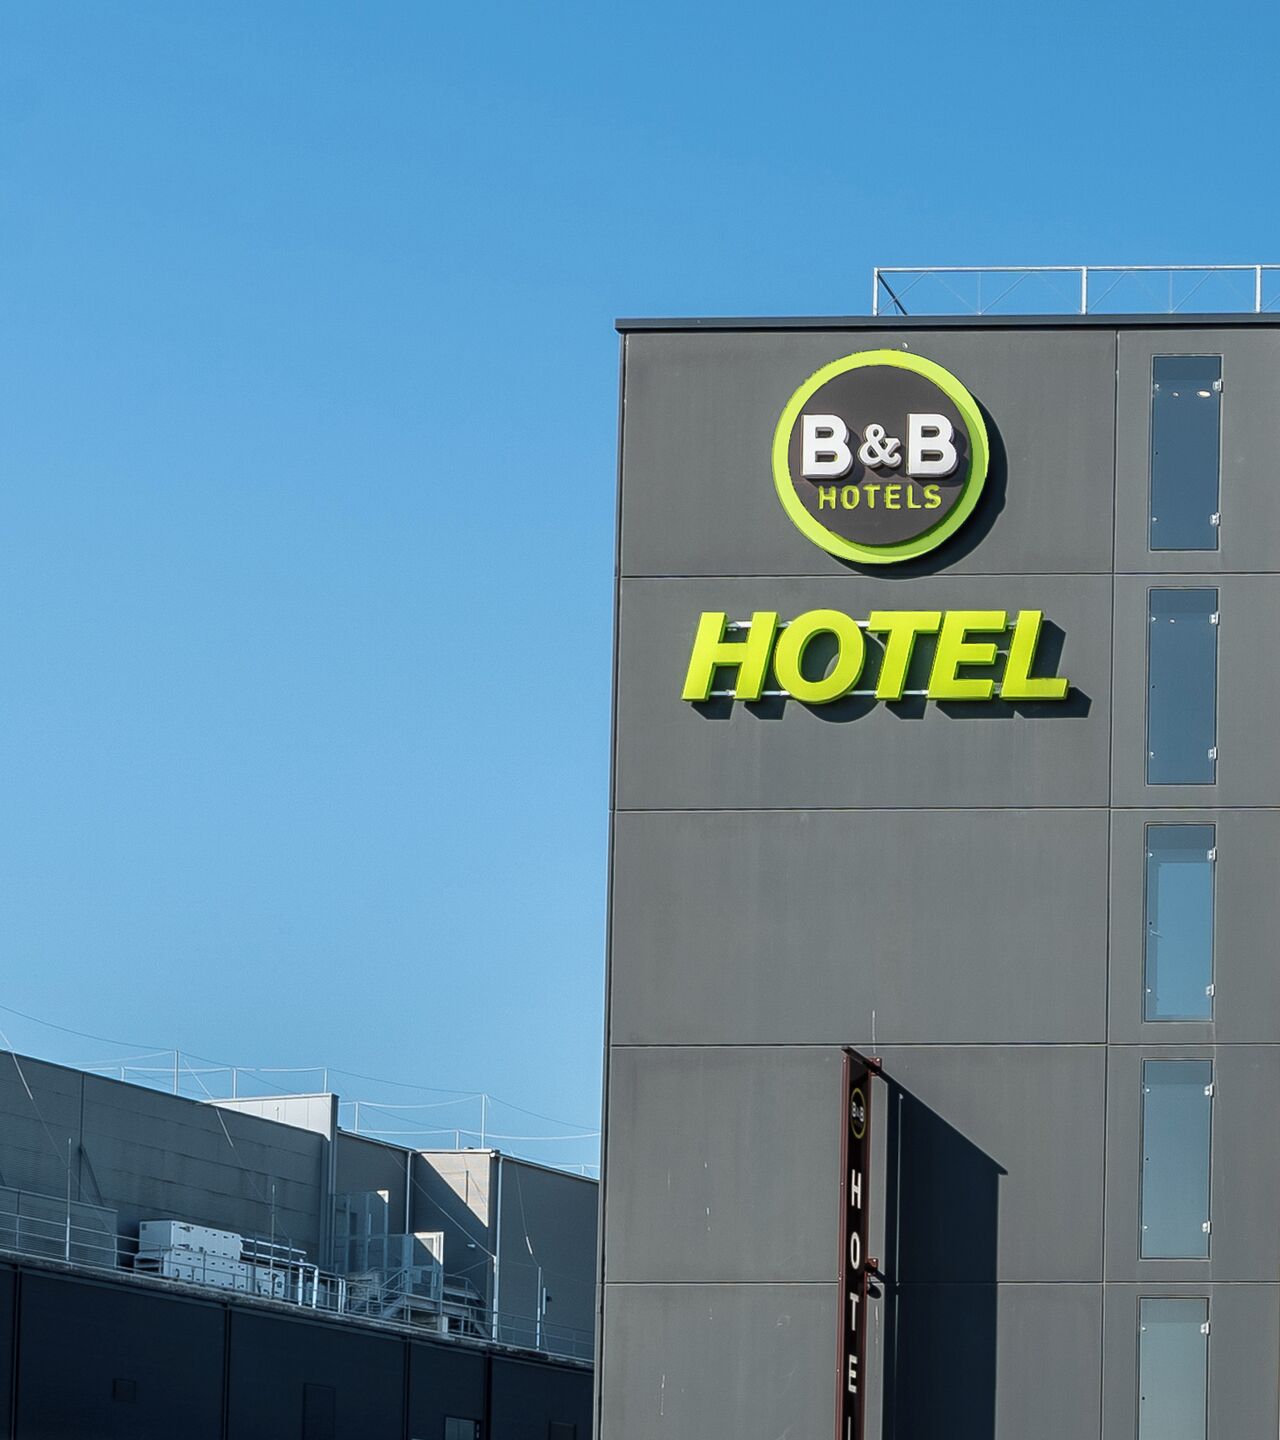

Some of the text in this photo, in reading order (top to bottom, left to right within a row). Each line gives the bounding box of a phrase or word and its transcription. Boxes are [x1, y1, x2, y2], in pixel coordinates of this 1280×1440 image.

[802, 413, 958, 478] B&B
[818, 484, 942, 509] HOTELS
[681, 609, 1070, 704] HOTEL
